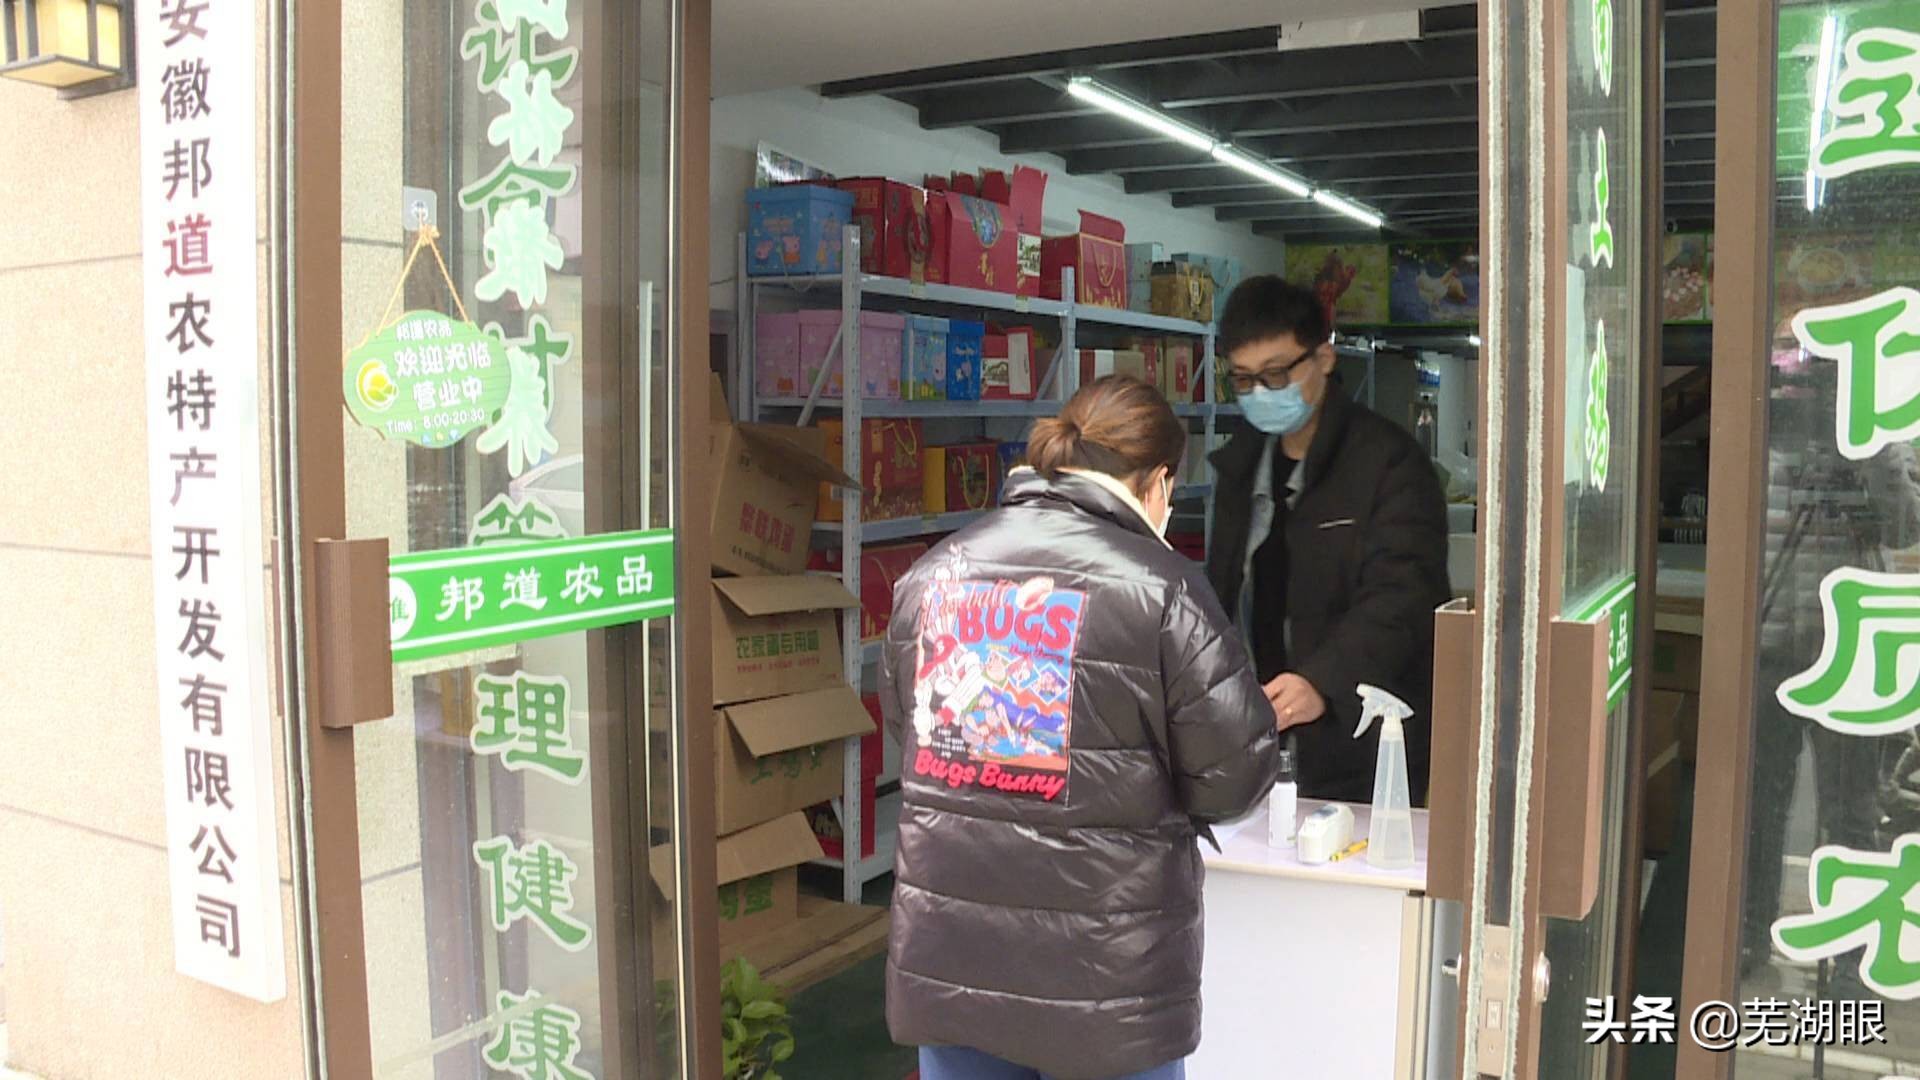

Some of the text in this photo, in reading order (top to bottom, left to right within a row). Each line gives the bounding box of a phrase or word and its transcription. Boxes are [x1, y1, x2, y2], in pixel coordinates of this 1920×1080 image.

[394, 341, 492, 377] 欢迎光临
[413, 375, 482, 411] 营业中
[160, 0, 243, 958] 安徽邦道农特产开发有限公司
[435, 554, 653, 621] 邦道农品
[958, 602, 1077, 650] BUGS
[914, 749, 1066, 800] Bugs Bunny
